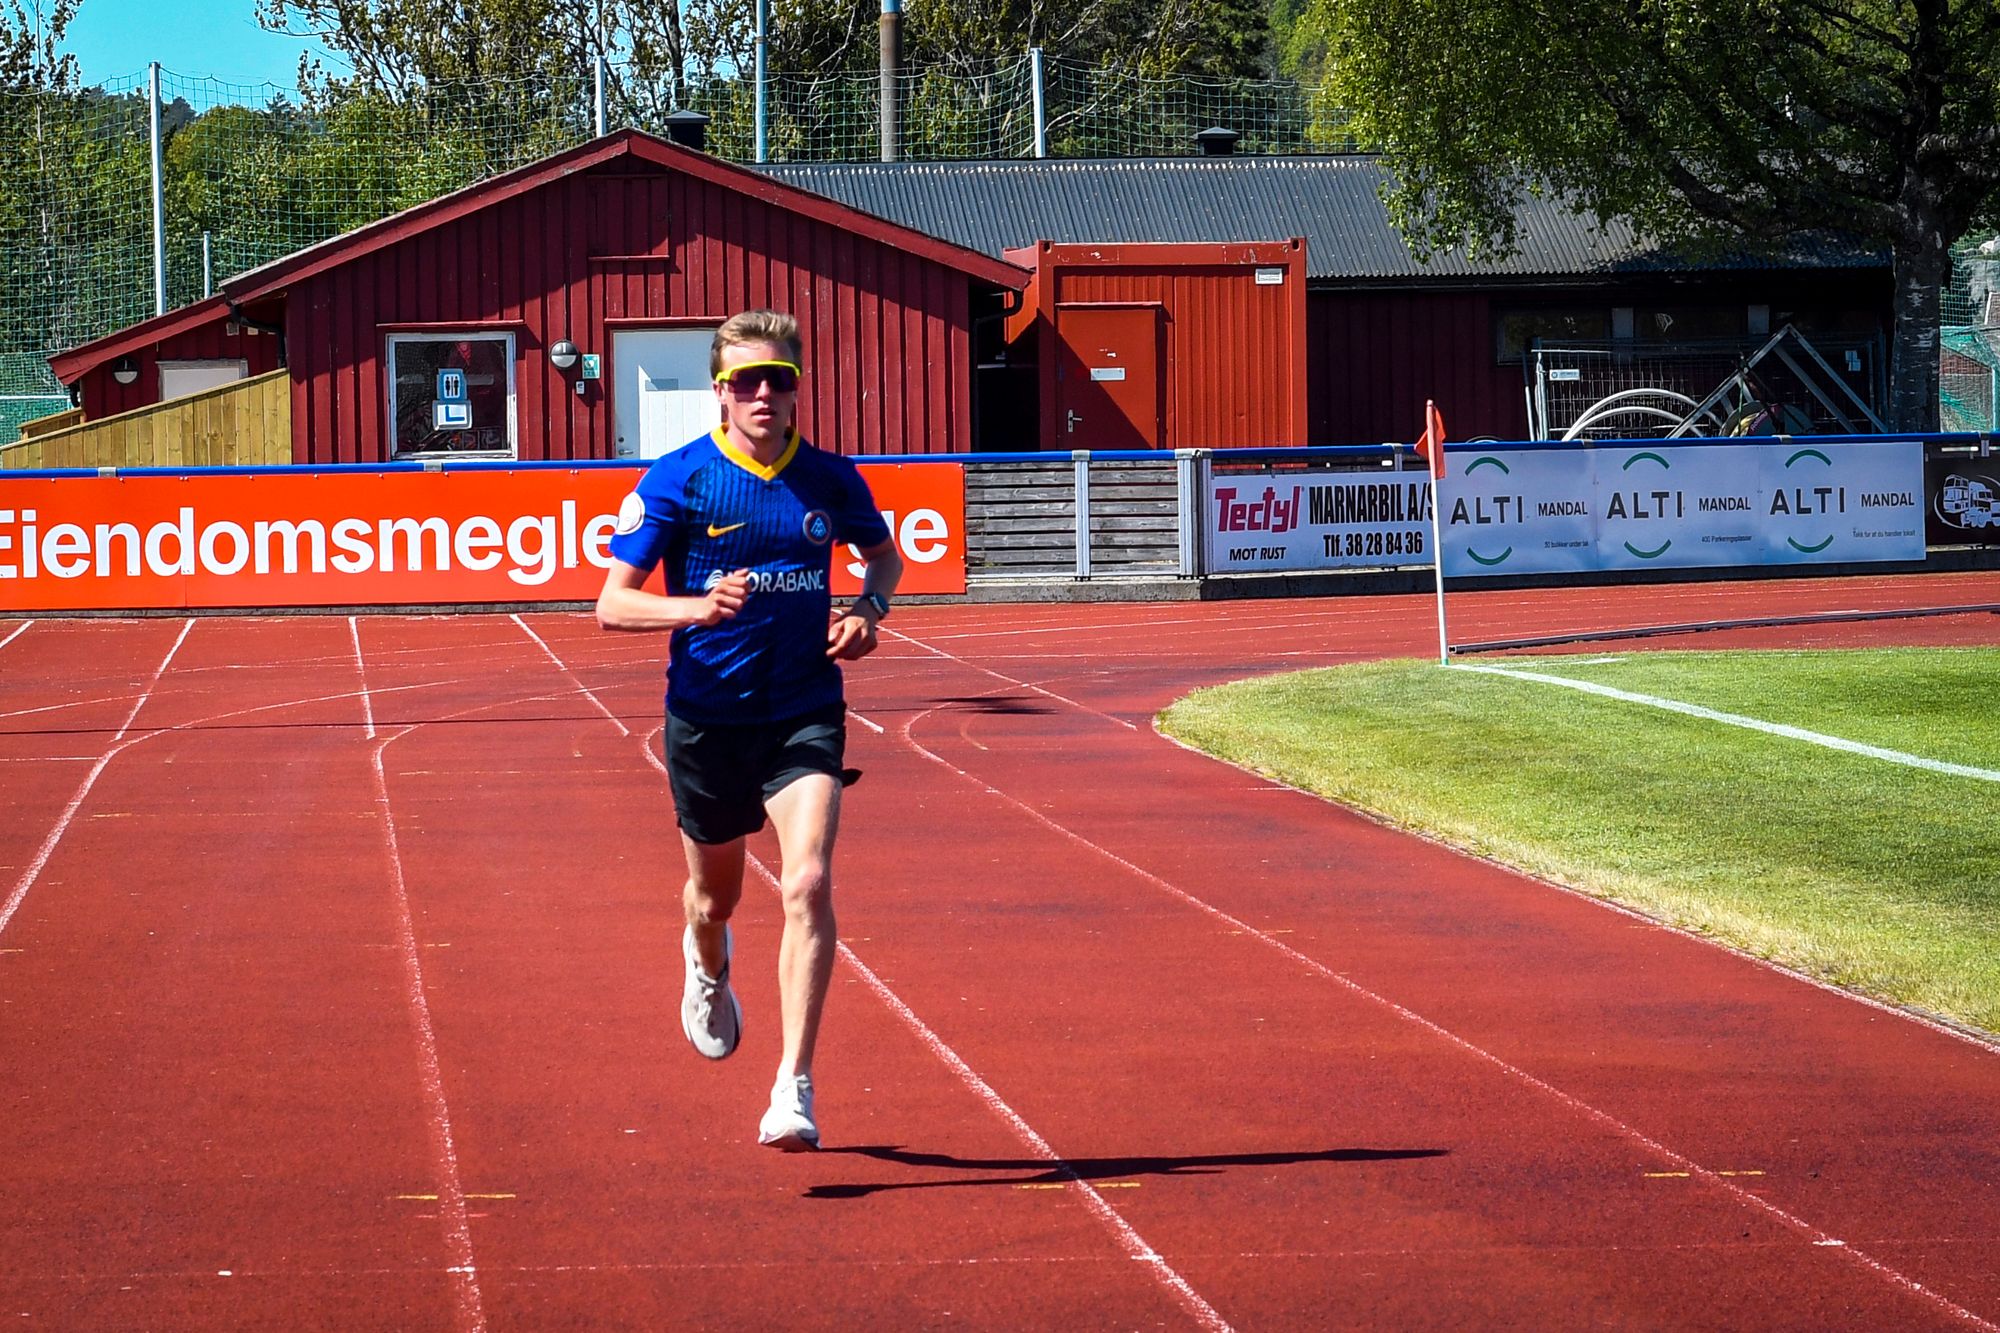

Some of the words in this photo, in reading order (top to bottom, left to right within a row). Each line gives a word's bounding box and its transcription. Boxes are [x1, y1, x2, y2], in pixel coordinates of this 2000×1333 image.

[1215, 486, 1301, 532] Tectyl
[1309, 484, 1404, 524] MARNARBIL
[1451, 496, 1523, 524] ALTI
[1538, 502, 1588, 516] MANDAL
[1607, 491, 1683, 519] ALTI
[1699, 497, 1751, 511] MANDAL
[1770, 488, 1845, 515] ALTI
[1861, 492, 1915, 507] MANDAL
[1230, 548, 1258, 561] MOT
[1260, 546, 1287, 560] RUST
[1323, 534, 1343, 557] Tlf.
[1345, 533, 1362, 556] 38
[1366, 532, 1382, 555] 28
[1386, 532, 1403, 555] 84
[1405, 531, 1423, 554] 36
[727, 569, 825, 593] ORABANC
